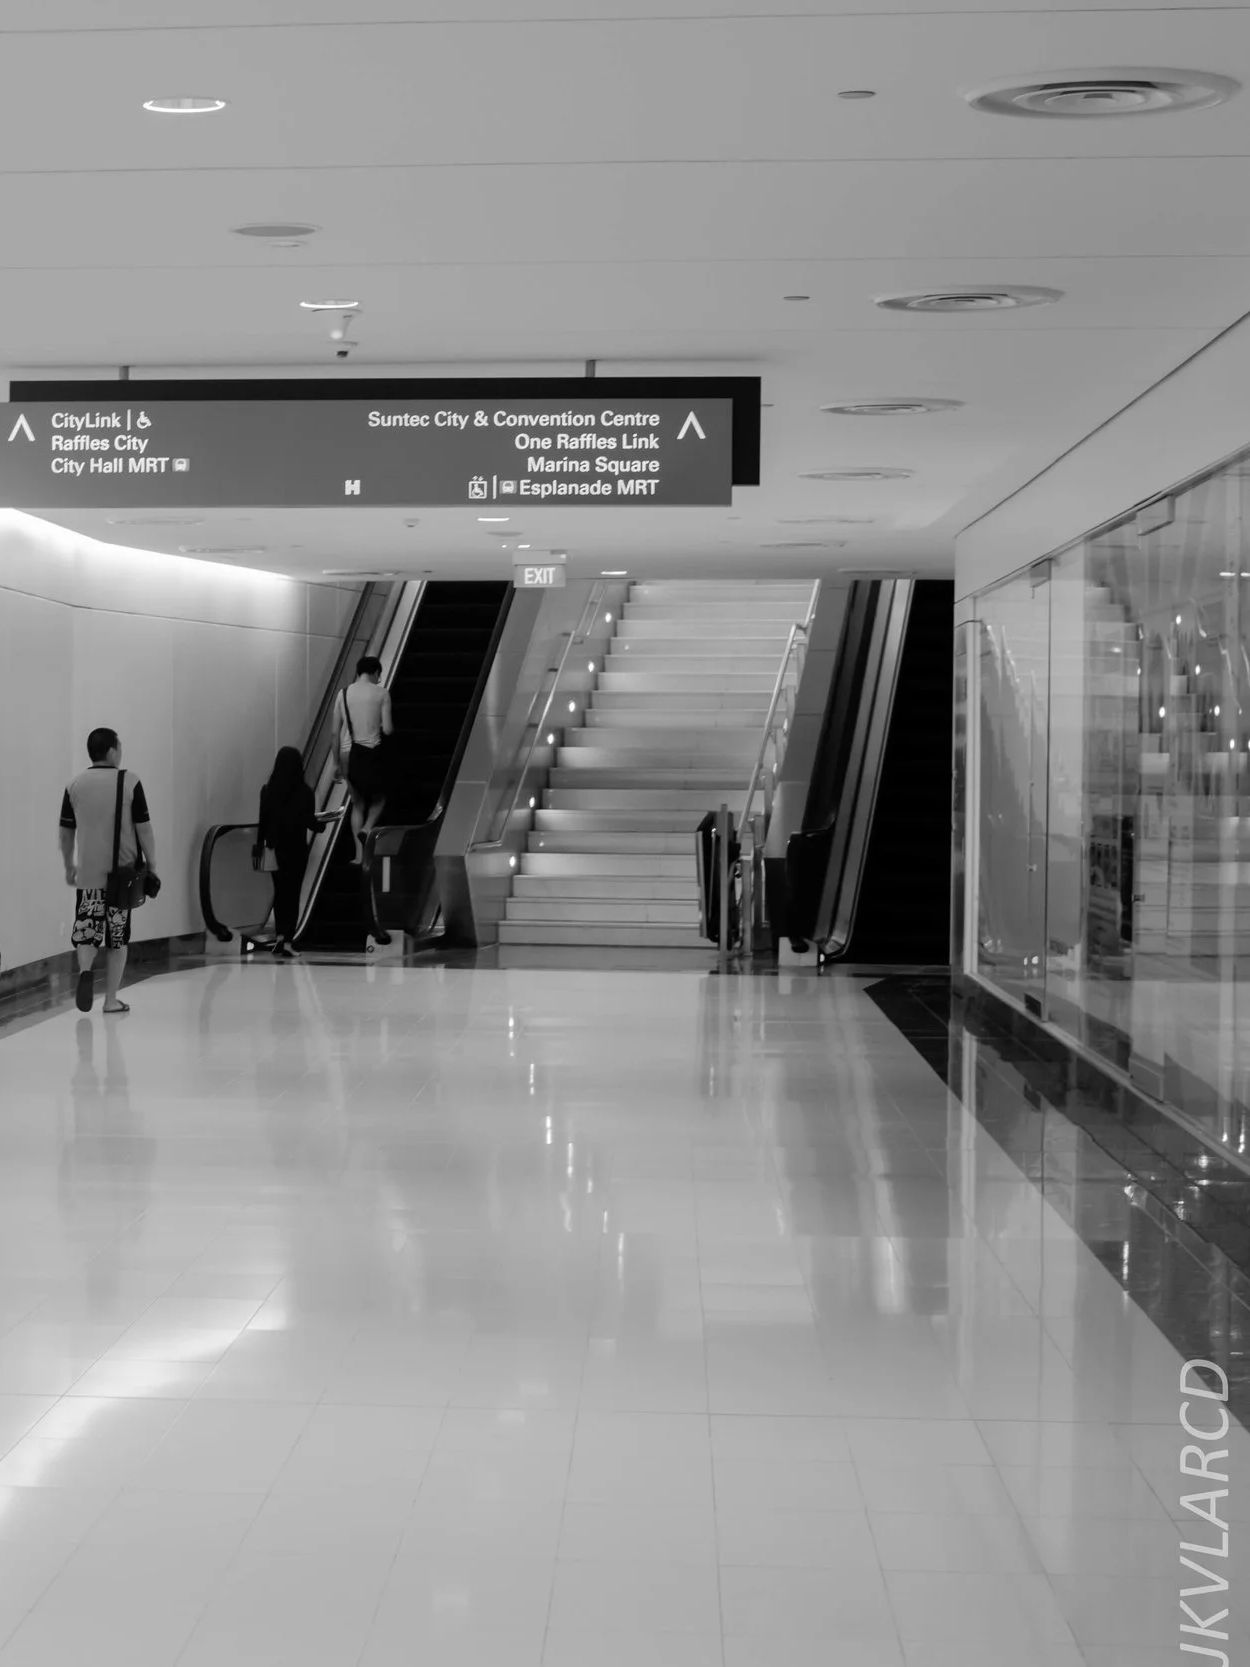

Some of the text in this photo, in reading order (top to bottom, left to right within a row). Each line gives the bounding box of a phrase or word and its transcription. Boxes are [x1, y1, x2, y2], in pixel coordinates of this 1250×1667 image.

[50, 411, 122, 432] CityLink
[367, 410, 661, 431] Suntec City & Convention Centre
[50, 434, 149, 455] Raffles City
[514, 432, 660, 450] One Raffles Link
[50, 456, 169, 478] City Hall MRT
[527, 455, 661, 476] Marina Square
[519, 478, 660, 499] Esplanade MRT
[524, 567, 556, 585] EXIT
